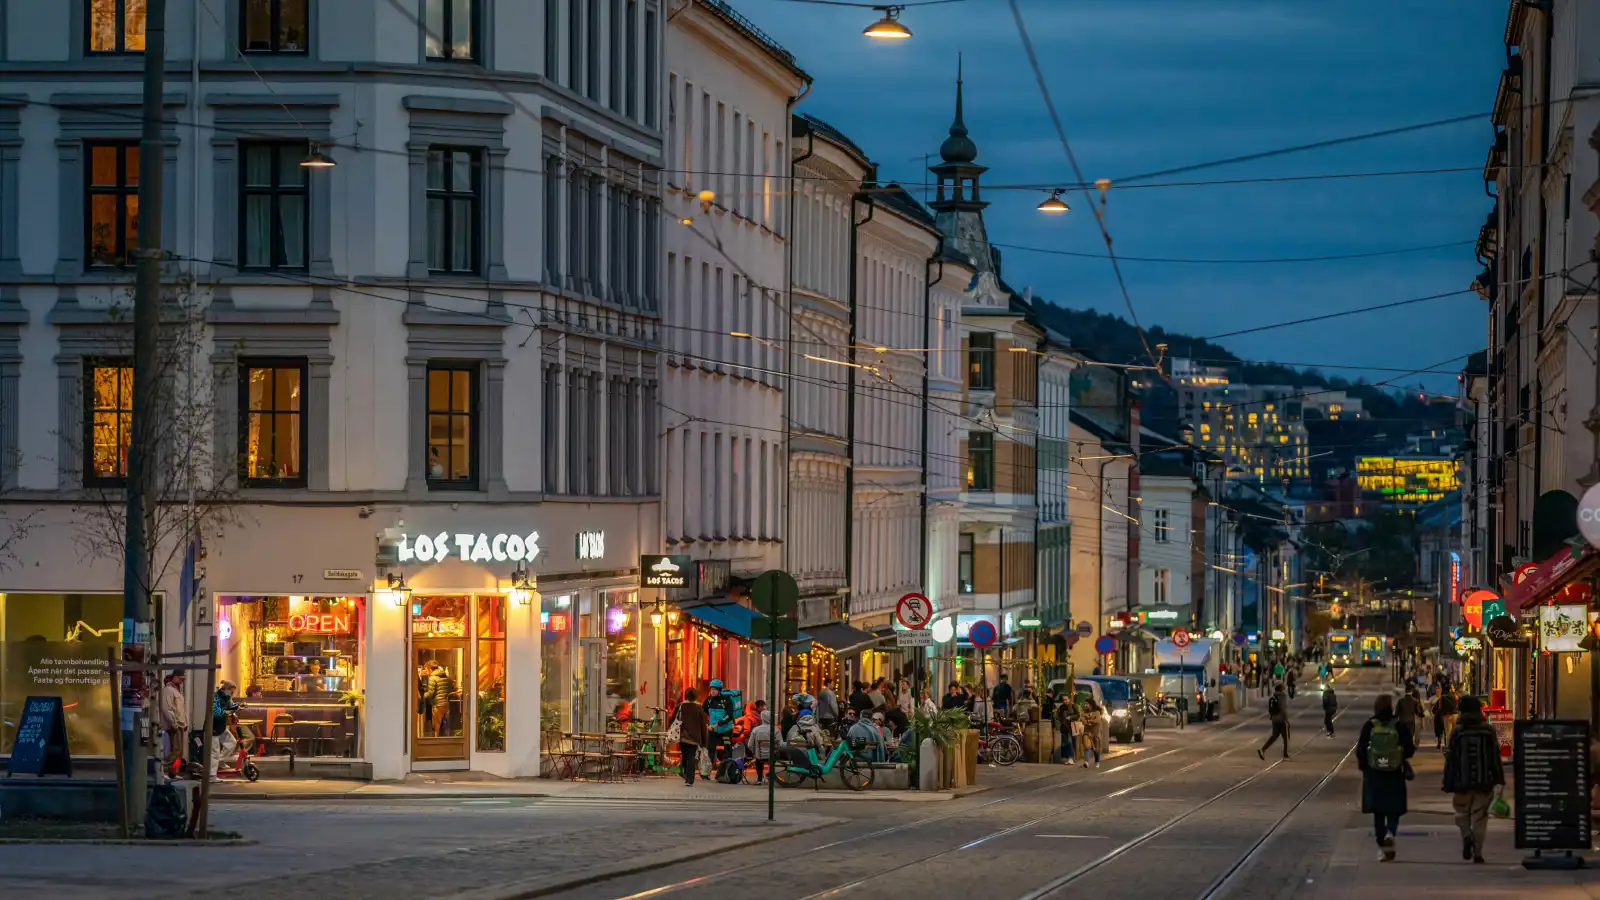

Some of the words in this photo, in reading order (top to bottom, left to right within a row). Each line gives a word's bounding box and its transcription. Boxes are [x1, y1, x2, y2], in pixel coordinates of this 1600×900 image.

[398, 531, 449, 563] LOS
[454, 530, 540, 563] TACOS
[292, 574, 304, 584] 17
[647, 577, 661, 585] LOS
[661, 577, 684, 585] TACOS
[289, 615, 349, 632] OPEN
[54, 658, 109, 666] tannbehandling
[28, 666, 49, 675] Åpent
[65, 677, 101, 685] fornuftige
